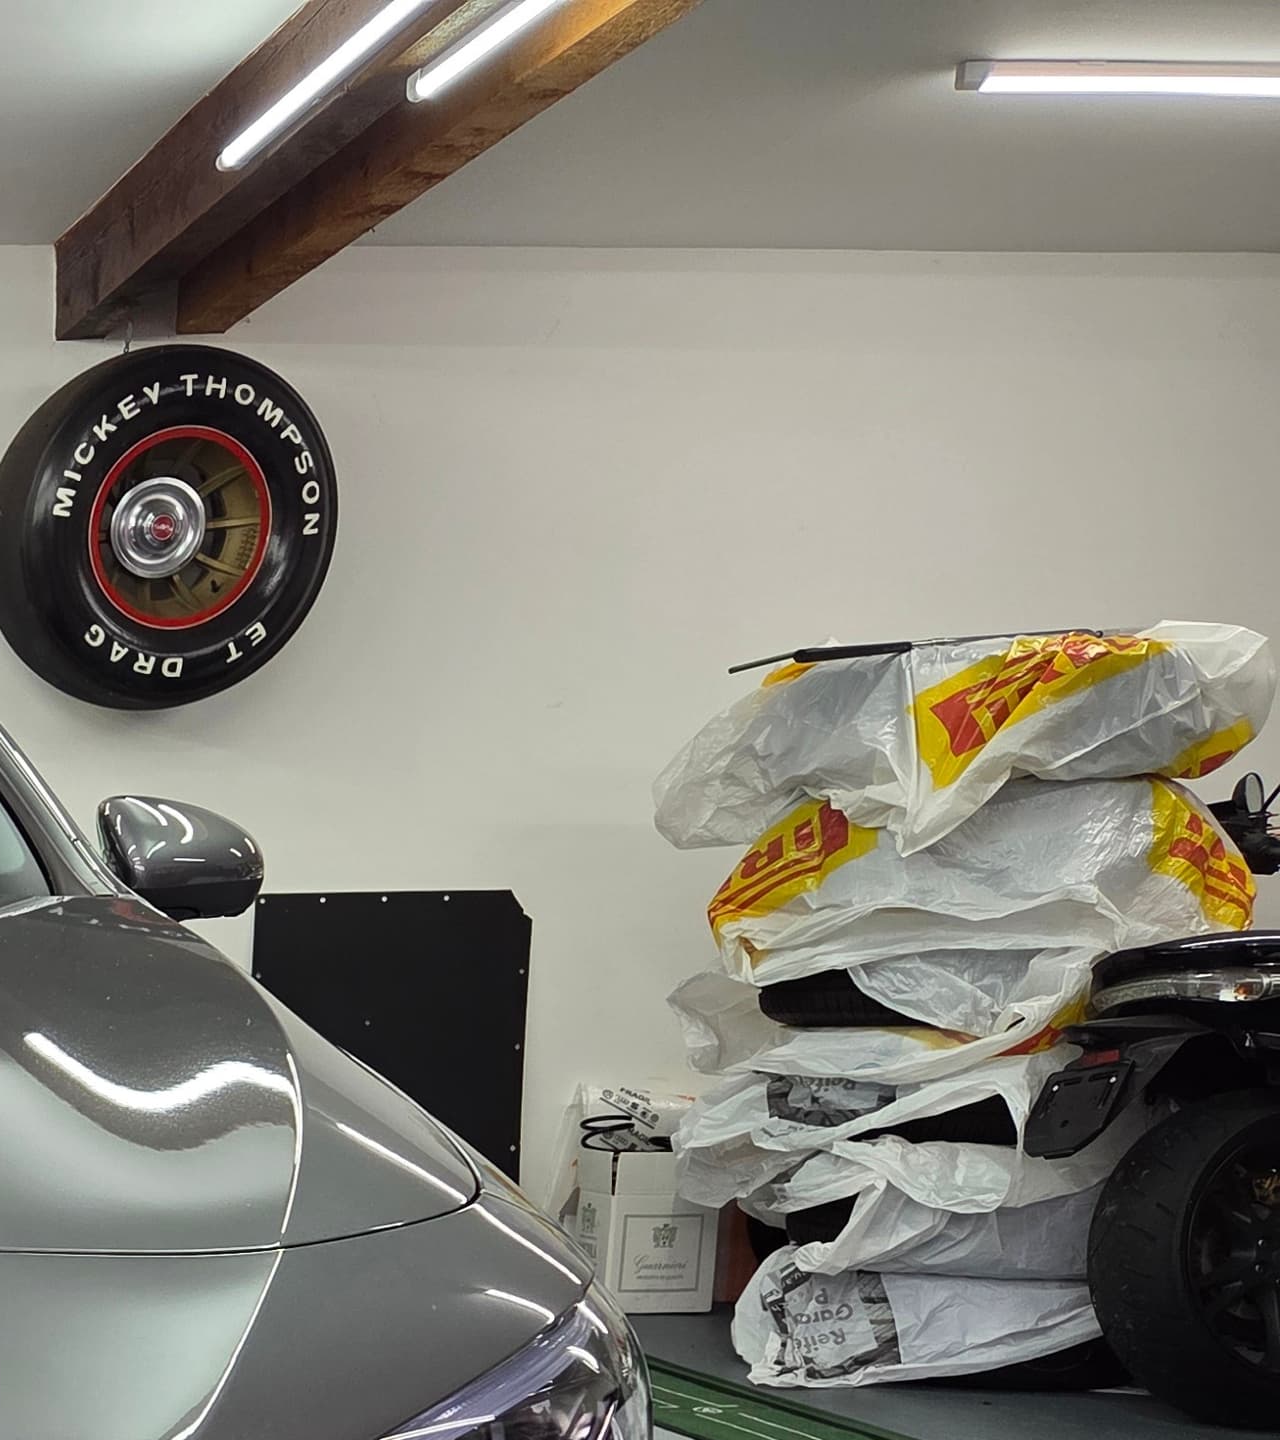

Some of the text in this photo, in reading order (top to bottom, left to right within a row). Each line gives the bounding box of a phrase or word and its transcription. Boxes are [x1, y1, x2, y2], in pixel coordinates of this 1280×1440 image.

[52, 373, 321, 536] MICKEY THOMPSON
[83, 621, 268, 679] ET DRAG
